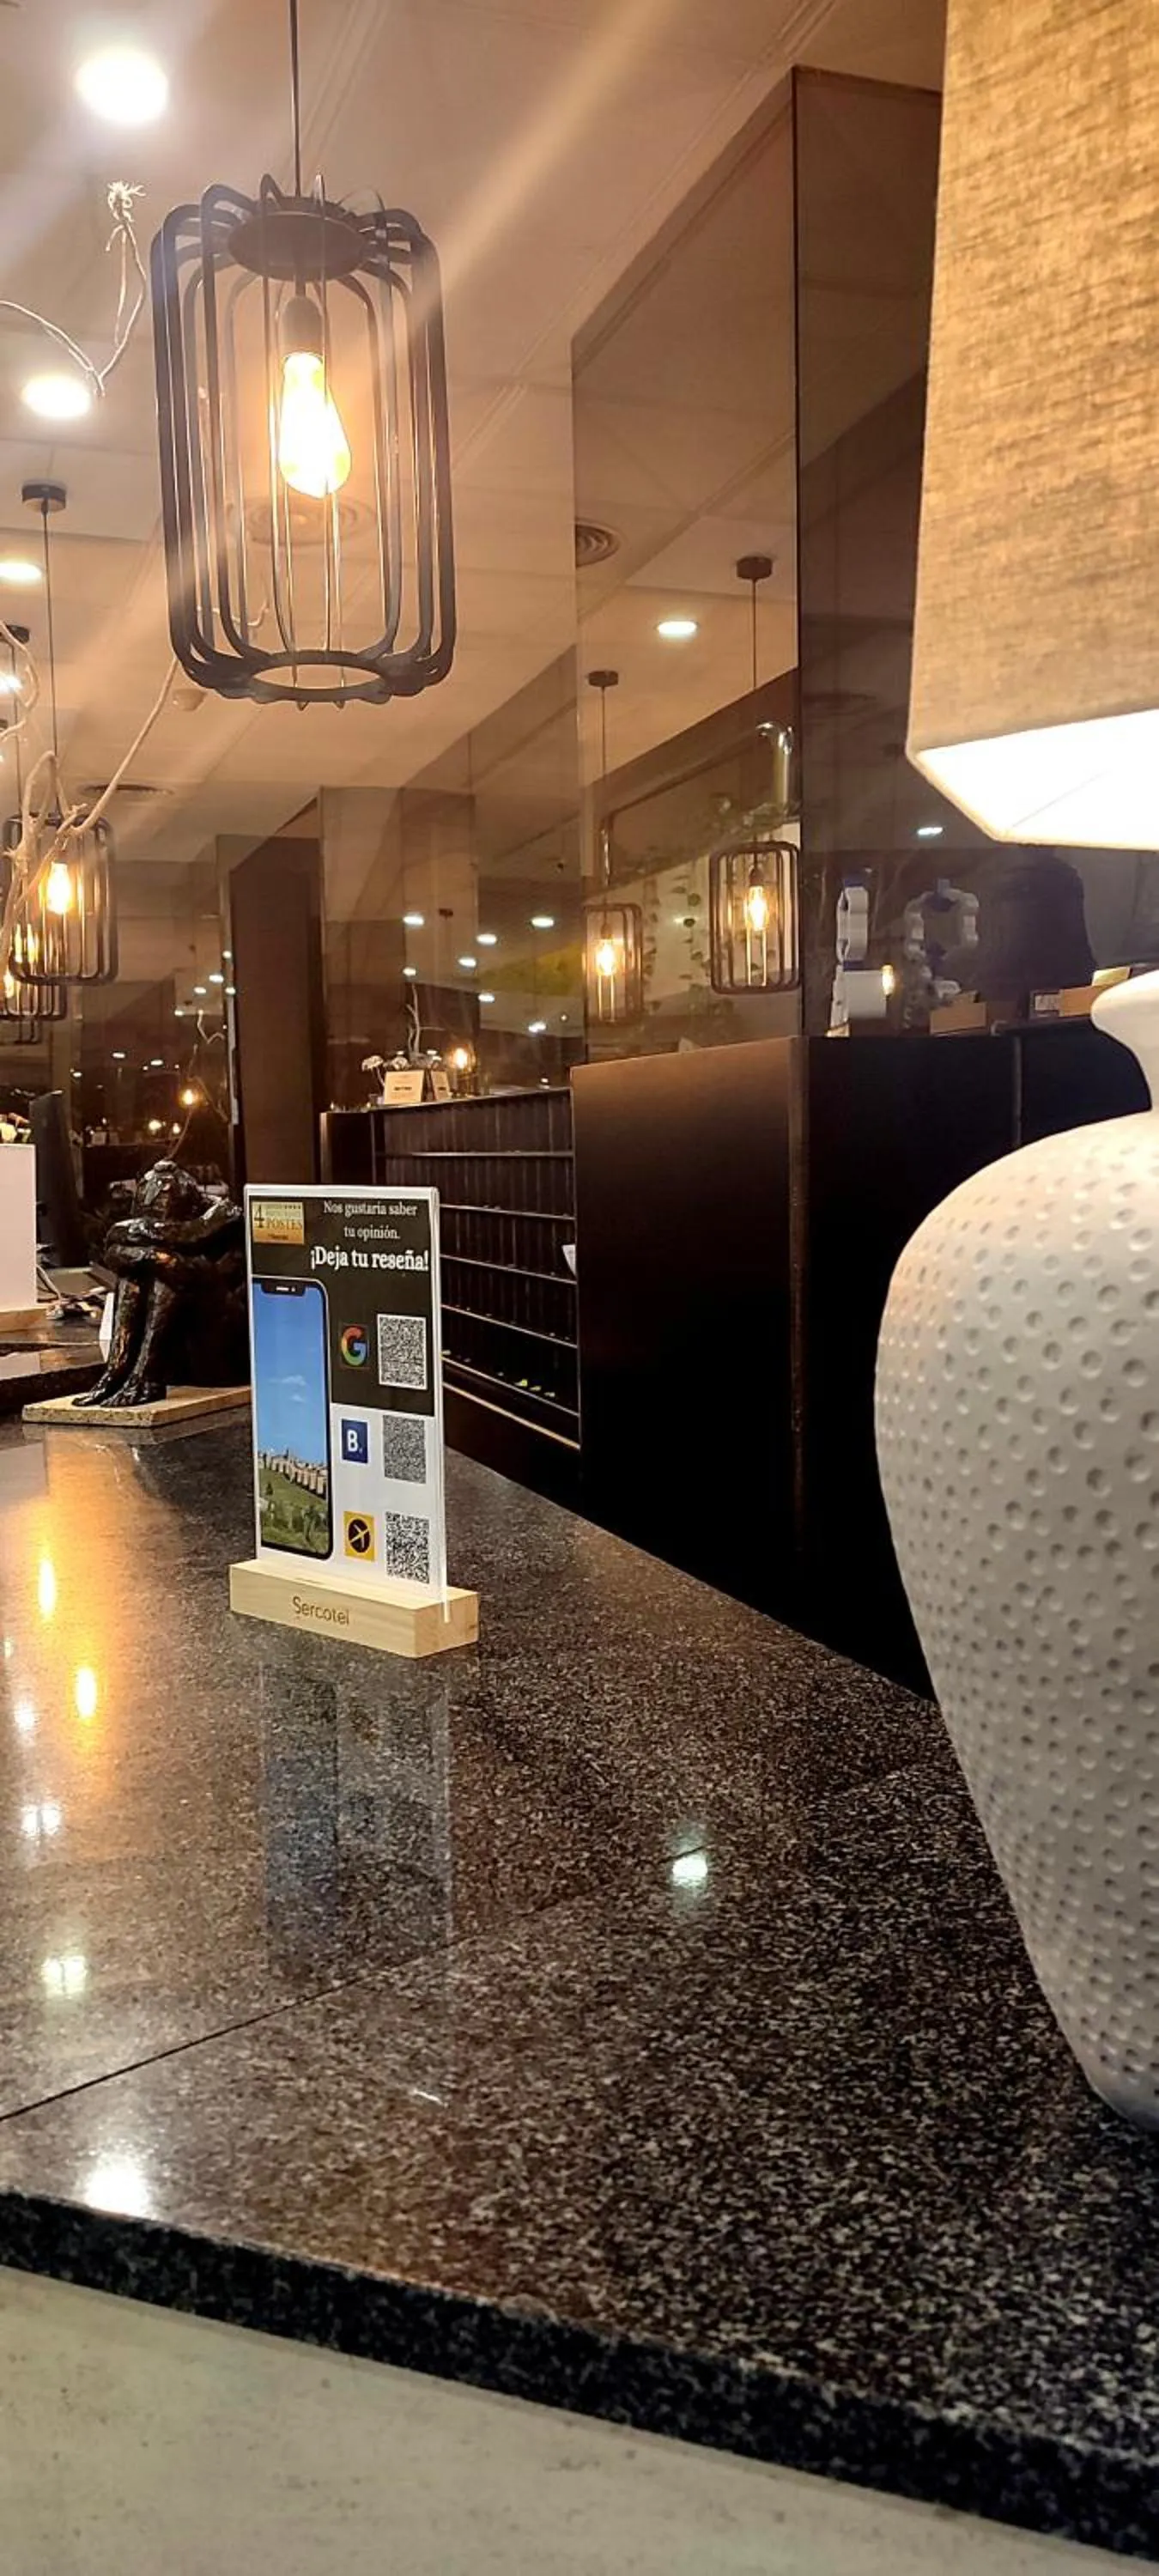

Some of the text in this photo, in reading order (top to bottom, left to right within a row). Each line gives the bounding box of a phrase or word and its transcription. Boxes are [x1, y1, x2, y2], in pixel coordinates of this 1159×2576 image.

[254, 1204, 265, 1229] 4
[324, 1200, 343, 1213] Nos
[388, 1202, 417, 1216] saber
[344, 1224, 401, 1242] tu opinión.
[310, 1245, 428, 1271] ¡Deja tu reseña!
[341, 1326, 367, 1366] G
[293, 1595, 349, 1625] Sercotel
